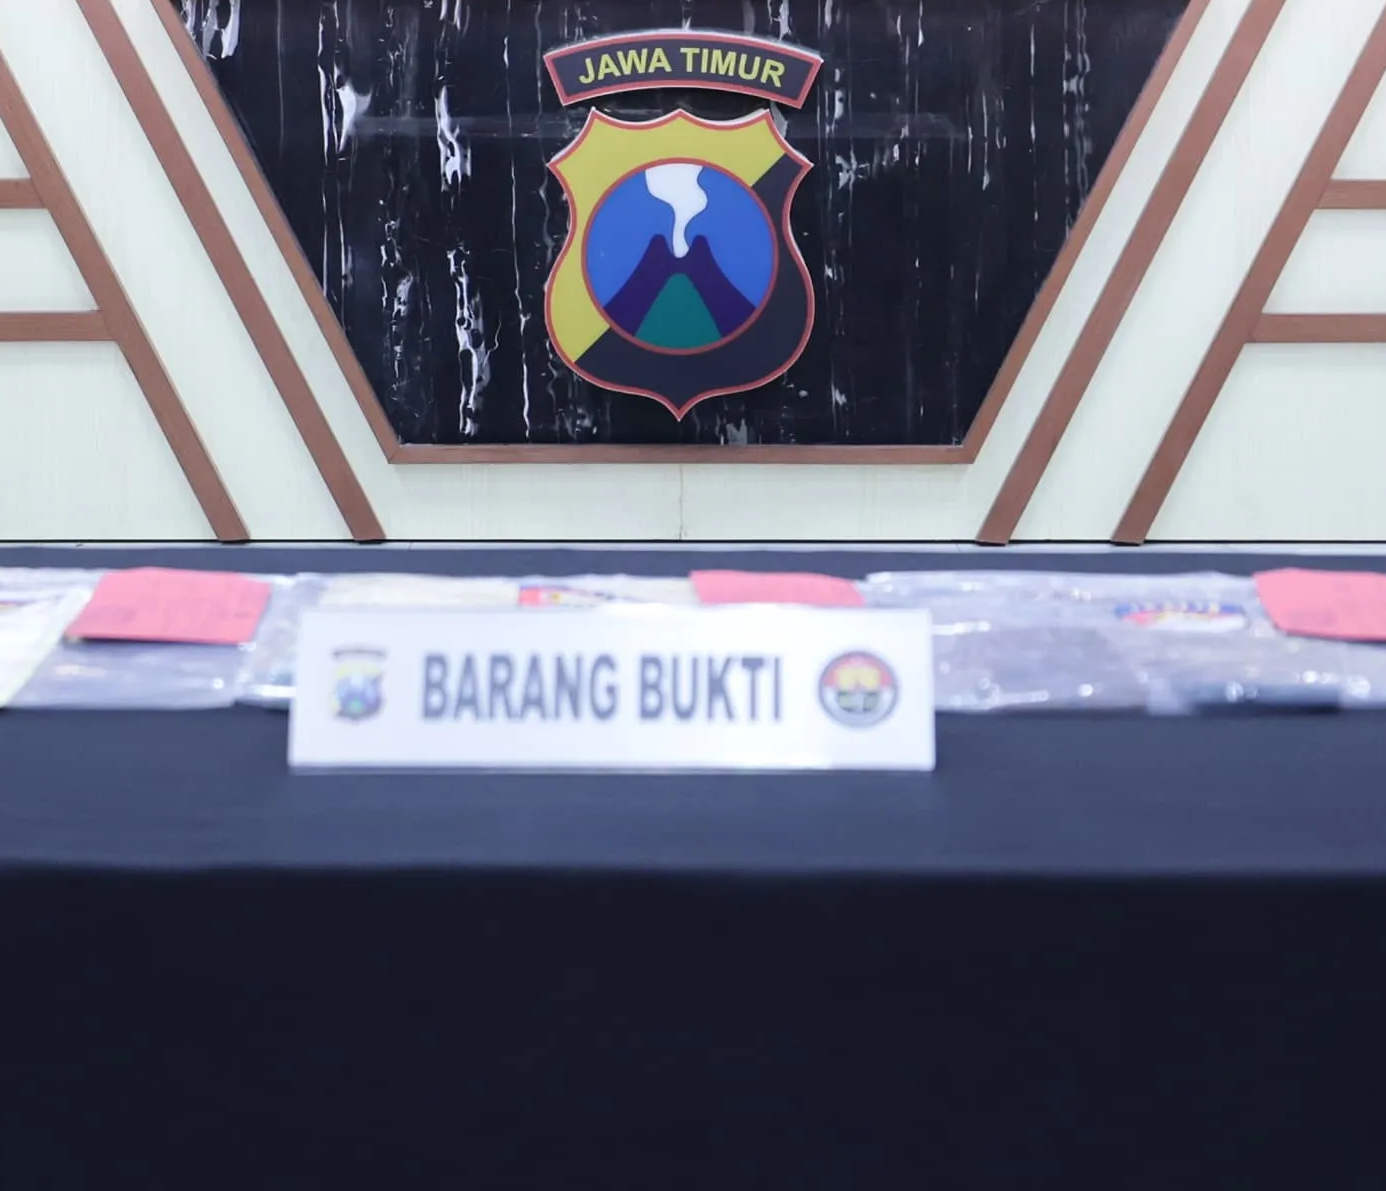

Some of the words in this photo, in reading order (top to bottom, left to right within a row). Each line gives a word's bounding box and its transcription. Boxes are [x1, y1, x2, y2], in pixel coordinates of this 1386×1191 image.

[579, 47, 672, 84] JAWA
[680, 47, 785, 87] TIMUR
[421, 654, 617, 720] BARANG
[639, 655, 782, 720] BUKTI
